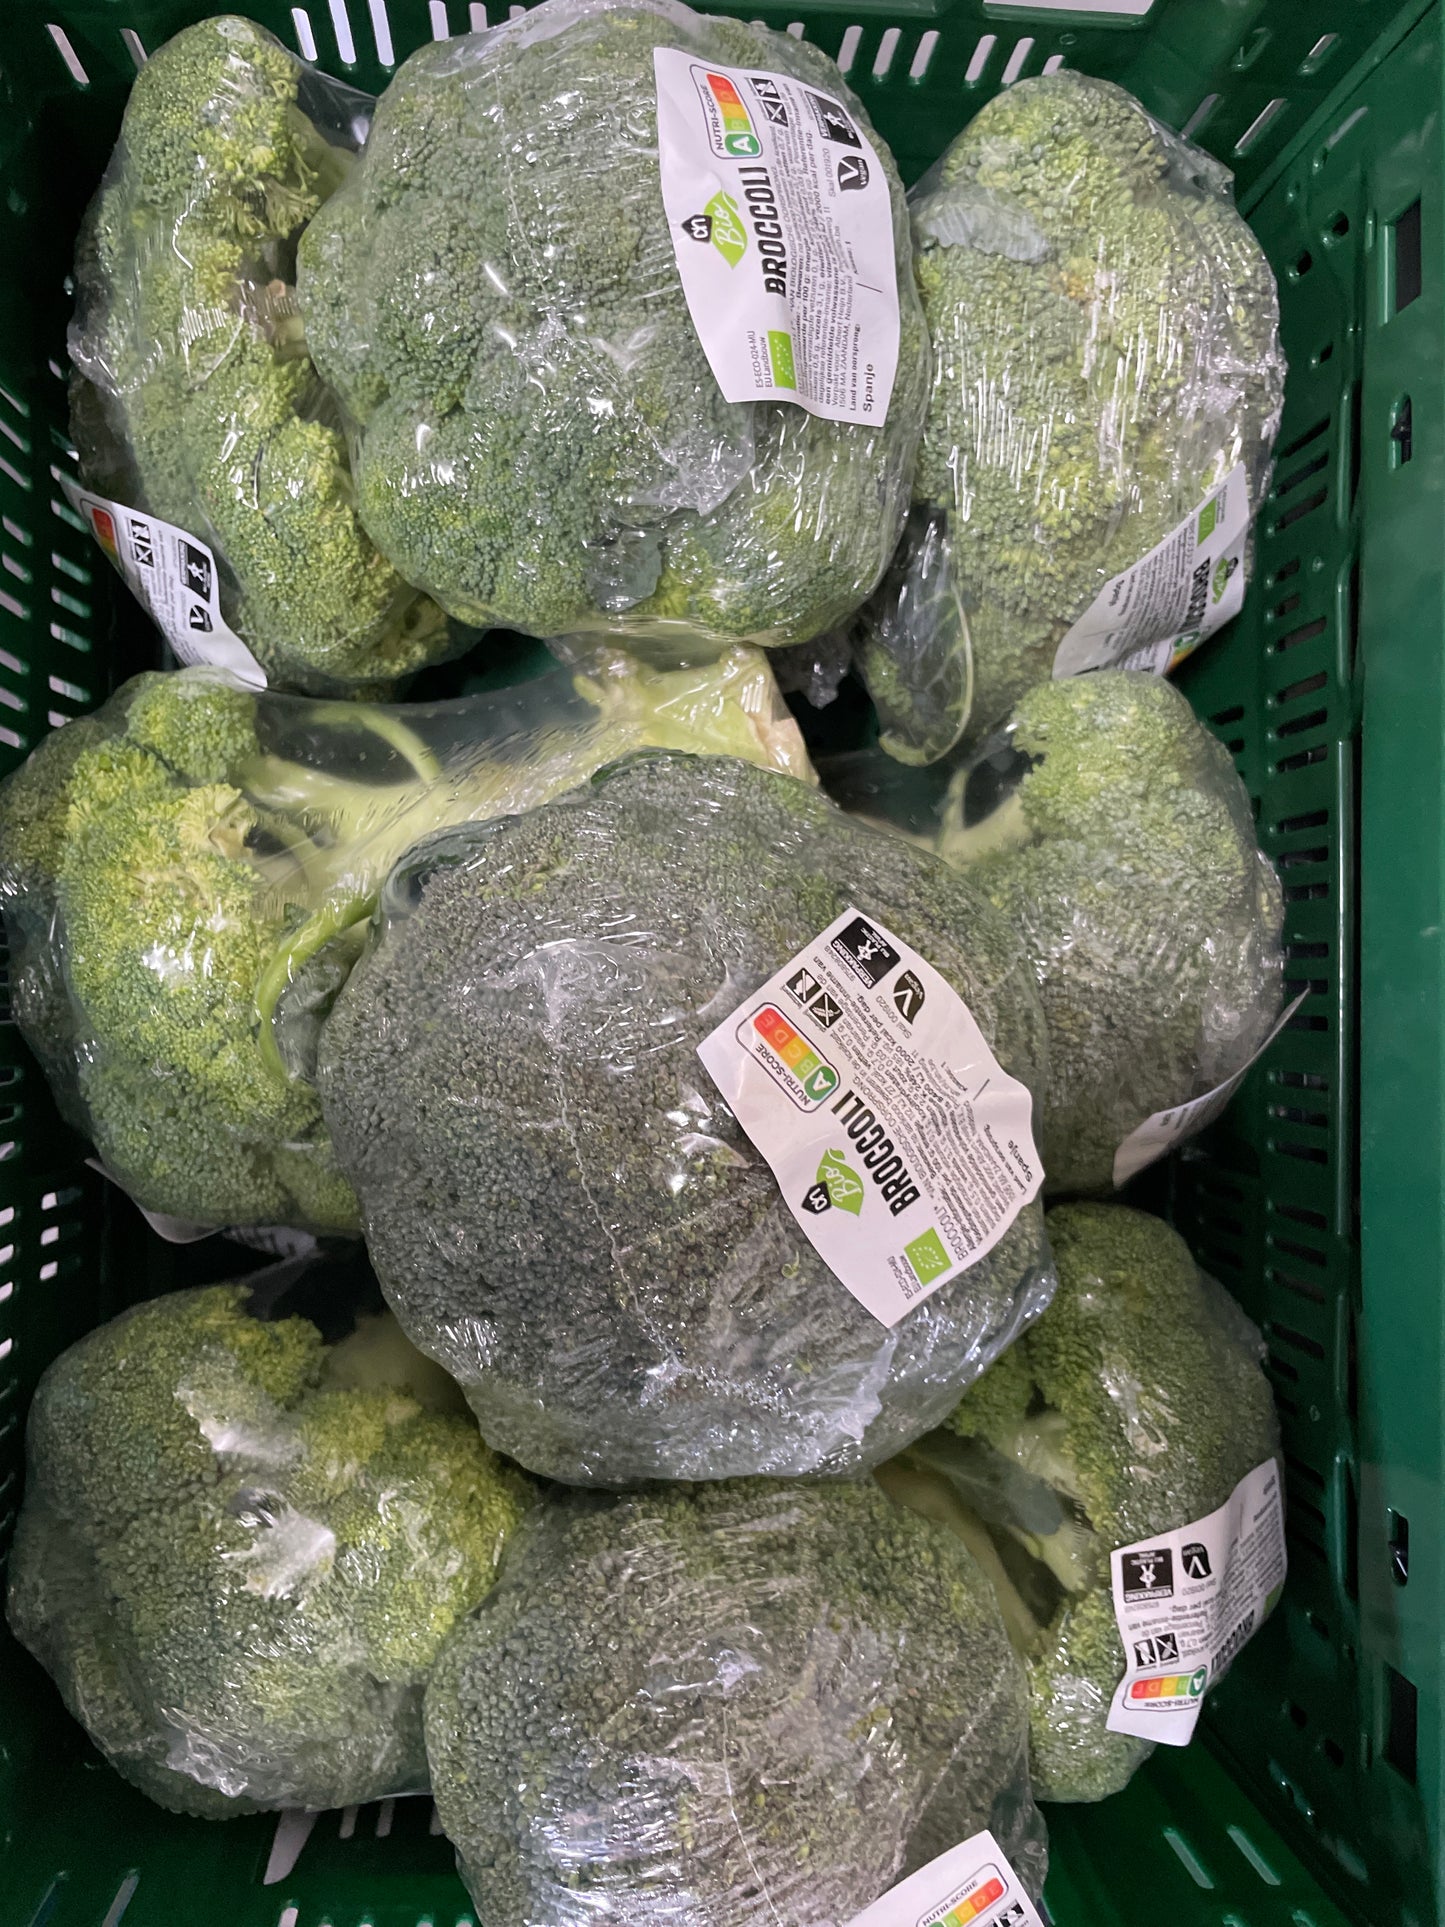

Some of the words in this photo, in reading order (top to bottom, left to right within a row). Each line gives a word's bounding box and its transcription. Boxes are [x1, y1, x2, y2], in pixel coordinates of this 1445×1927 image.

[700, 83, 723, 150] NUTRI-SCORE
[732, 135, 752, 152] A
[807, 152, 816, 168] per
[821, 147, 832, 178] 001920
[857, 158, 867, 185] Vegan
[813, 191, 822, 214] 2000
[712, 202, 744, 248] Bio
[738, 167, 786, 297] BROCCOLI
[758, 335, 770, 376] Landbouw
[825, 326, 834, 384] gemiddelde
[764, 377, 772, 387] EU
[839, 372, 846, 385] MA
[863, 363, 875, 412] Spanje
[812, 955, 828, 972] van
[831, 938, 875, 987] VERPAKKING
[814, 972, 828, 986] de
[823, 983, 839, 1000] van
[902, 972, 925, 1000] Vegan
[822, 970, 882, 1042] Referentie-inname
[852, 992, 871, 1014] dag.
[874, 994, 899, 1024] 001920
[835, 996, 871, 1042] Percentage
[841, 1017, 866, 1048] waarvan
[868, 1012, 884, 1028] per
[894, 1021, 912, 1039] Skal
[878, 1027, 897, 1046] kcal
[848, 1059, 861, 1071] de
[849, 1044, 873, 1070] vetten
[894, 1044, 915, 1066] 2000
[754, 1042, 811, 1105] NUTRI-SCORE
[812, 1069, 832, 1091] A
[890, 1064, 908, 1084] zout
[864, 1075, 893, 1107] bewaren
[882, 1068, 927, 1121] koolhydraten
[884, 1084, 896, 1095] 27
[830, 1089, 920, 1216] BROCCOLI
[891, 1125, 927, 1179] BIOLOGISCHE
[1006, 1139, 1034, 1182] Spanje
[820, 1163, 862, 1202] Bio
[1193, 1675, 1203, 1690] A
[921, 1879, 978, 1926] NUTRI-SCORE
